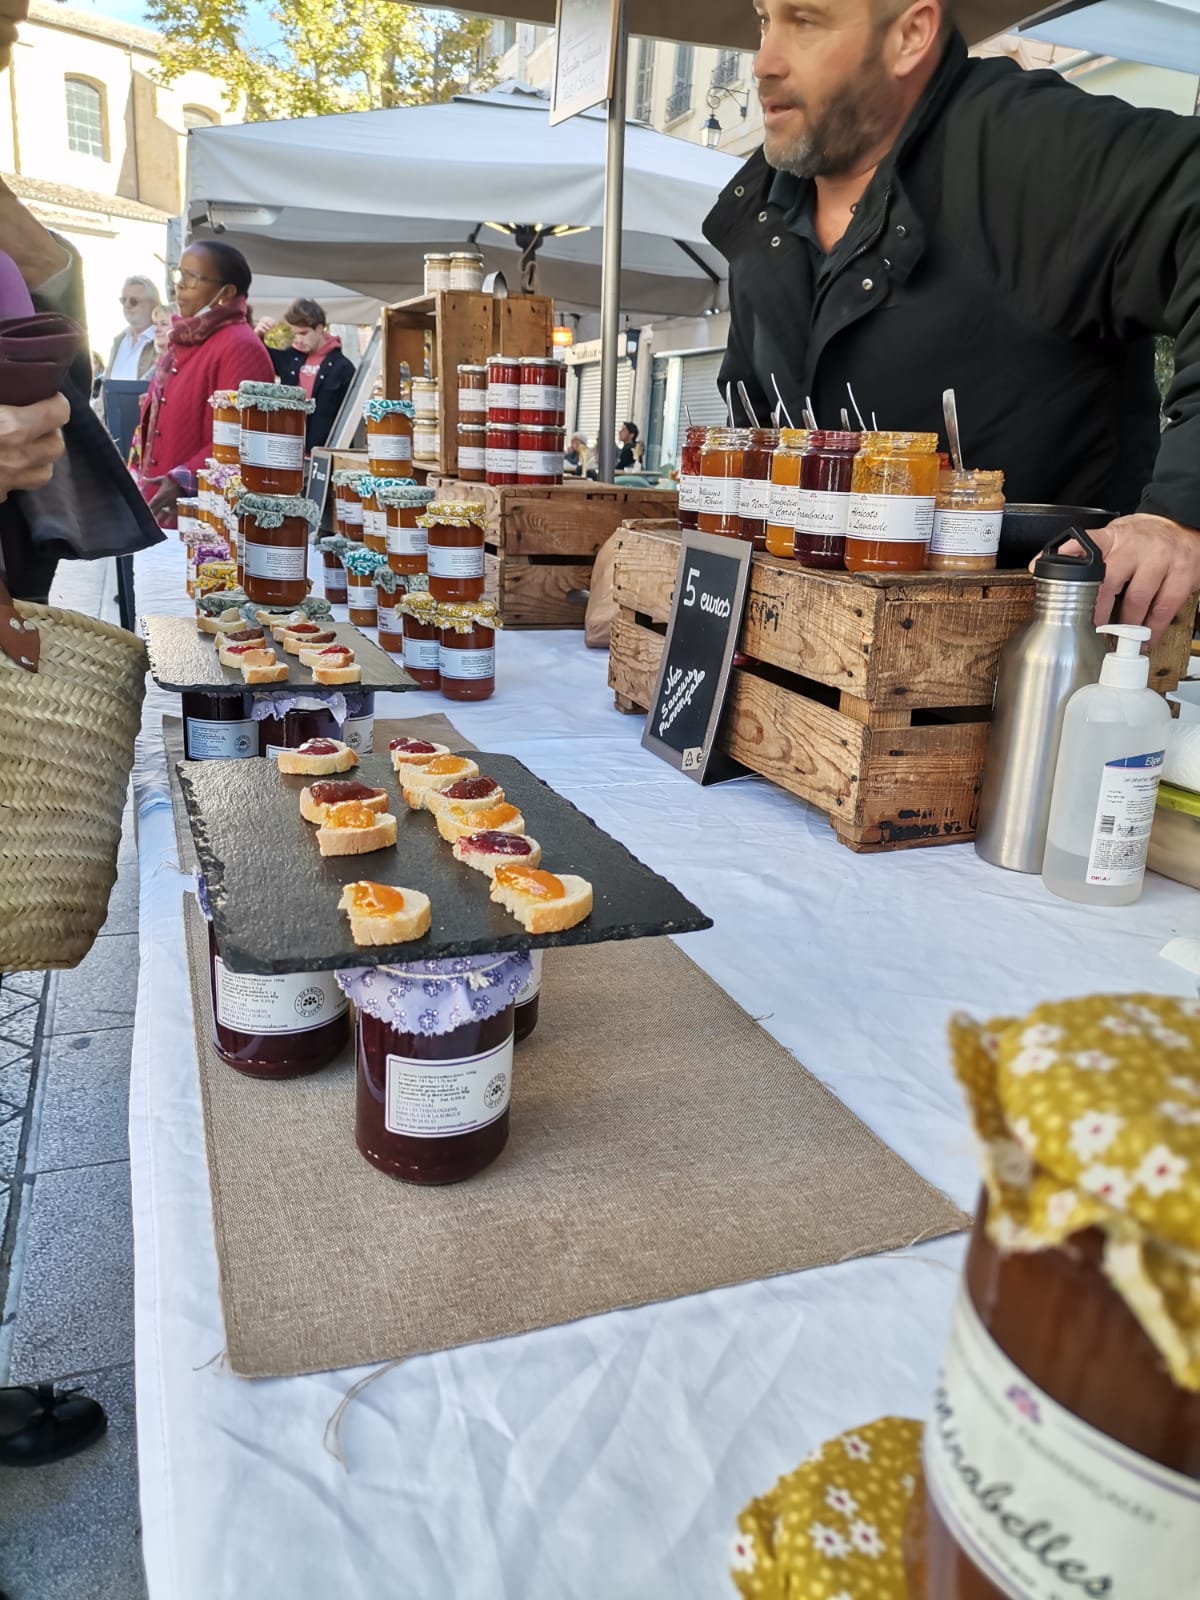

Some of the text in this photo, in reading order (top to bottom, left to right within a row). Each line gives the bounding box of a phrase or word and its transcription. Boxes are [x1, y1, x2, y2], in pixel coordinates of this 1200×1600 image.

[797, 506, 834, 521] ramboises
[852, 518, 888, 531] Lavande
[683, 567, 701, 607] 5
[700, 592, 731, 618] euros
[664, 665, 683, 695] Nos
